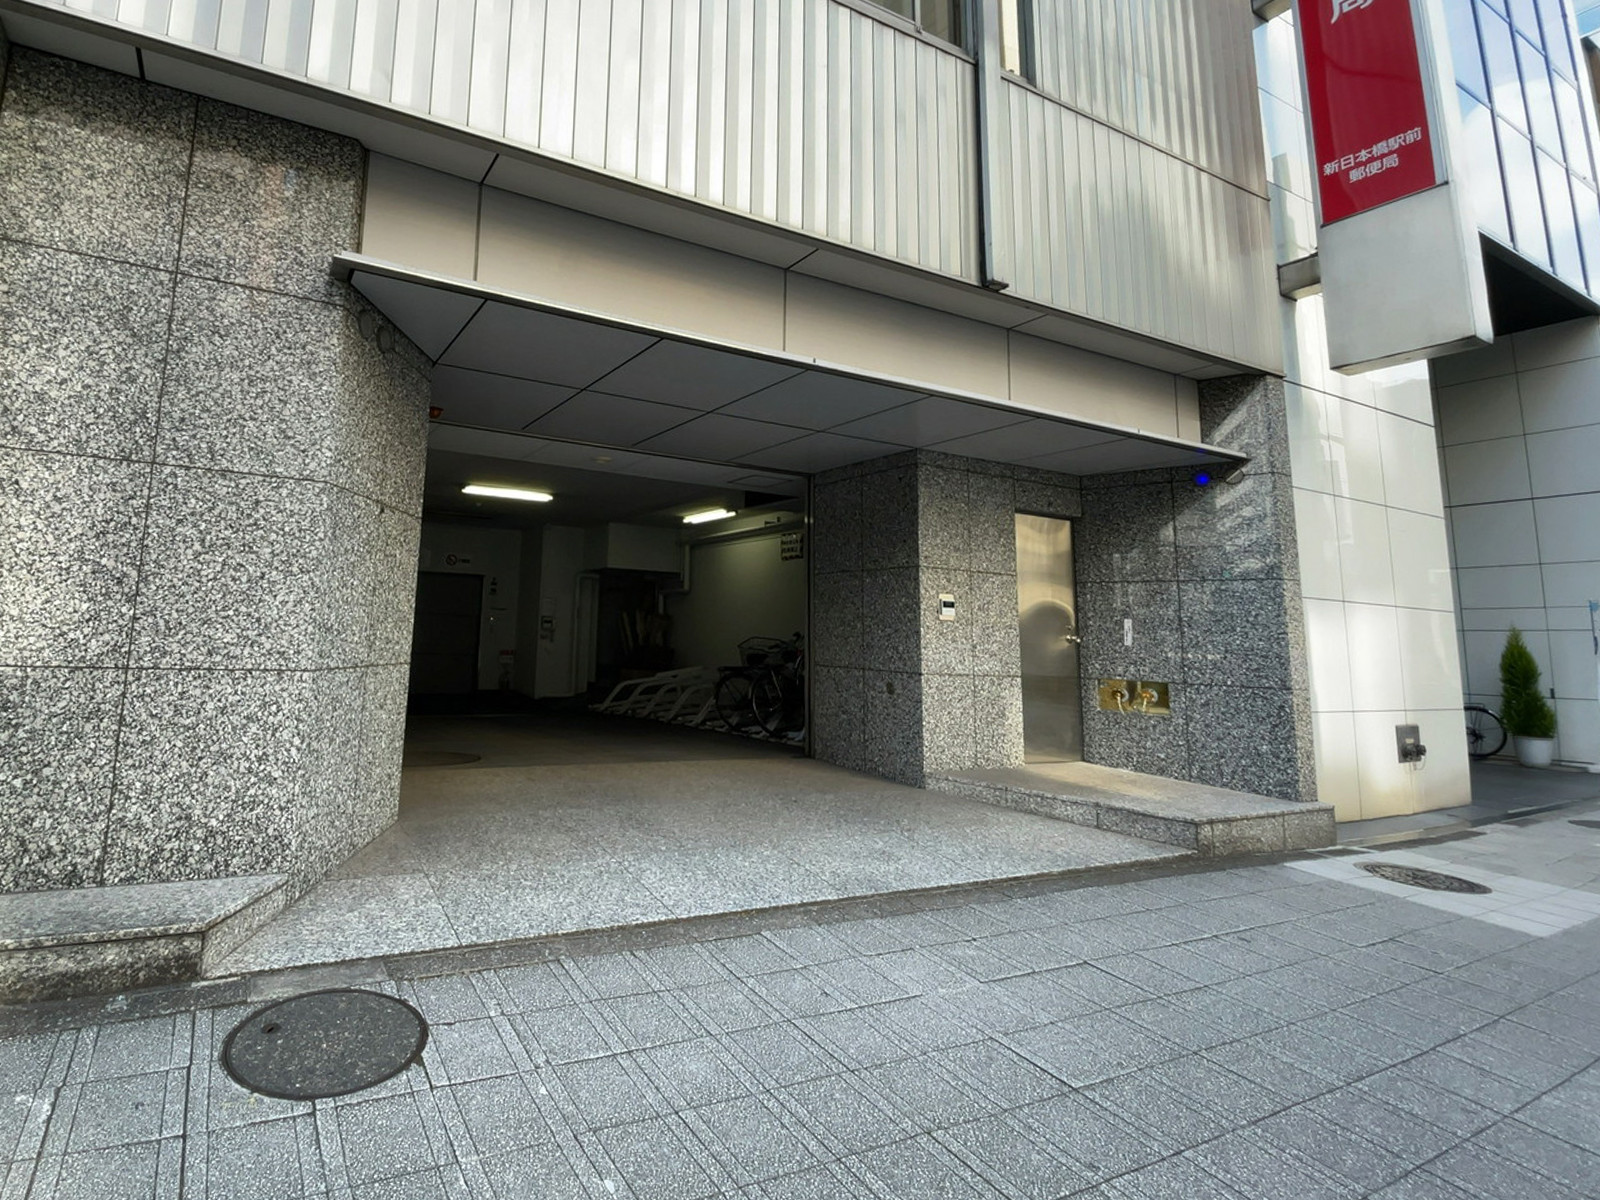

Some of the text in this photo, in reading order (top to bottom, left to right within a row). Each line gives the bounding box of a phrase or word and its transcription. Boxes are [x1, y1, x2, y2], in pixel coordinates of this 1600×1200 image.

[1323, 127, 1422, 176] 新日本橋駅前
[1348, 153, 1399, 183] 郵便局
